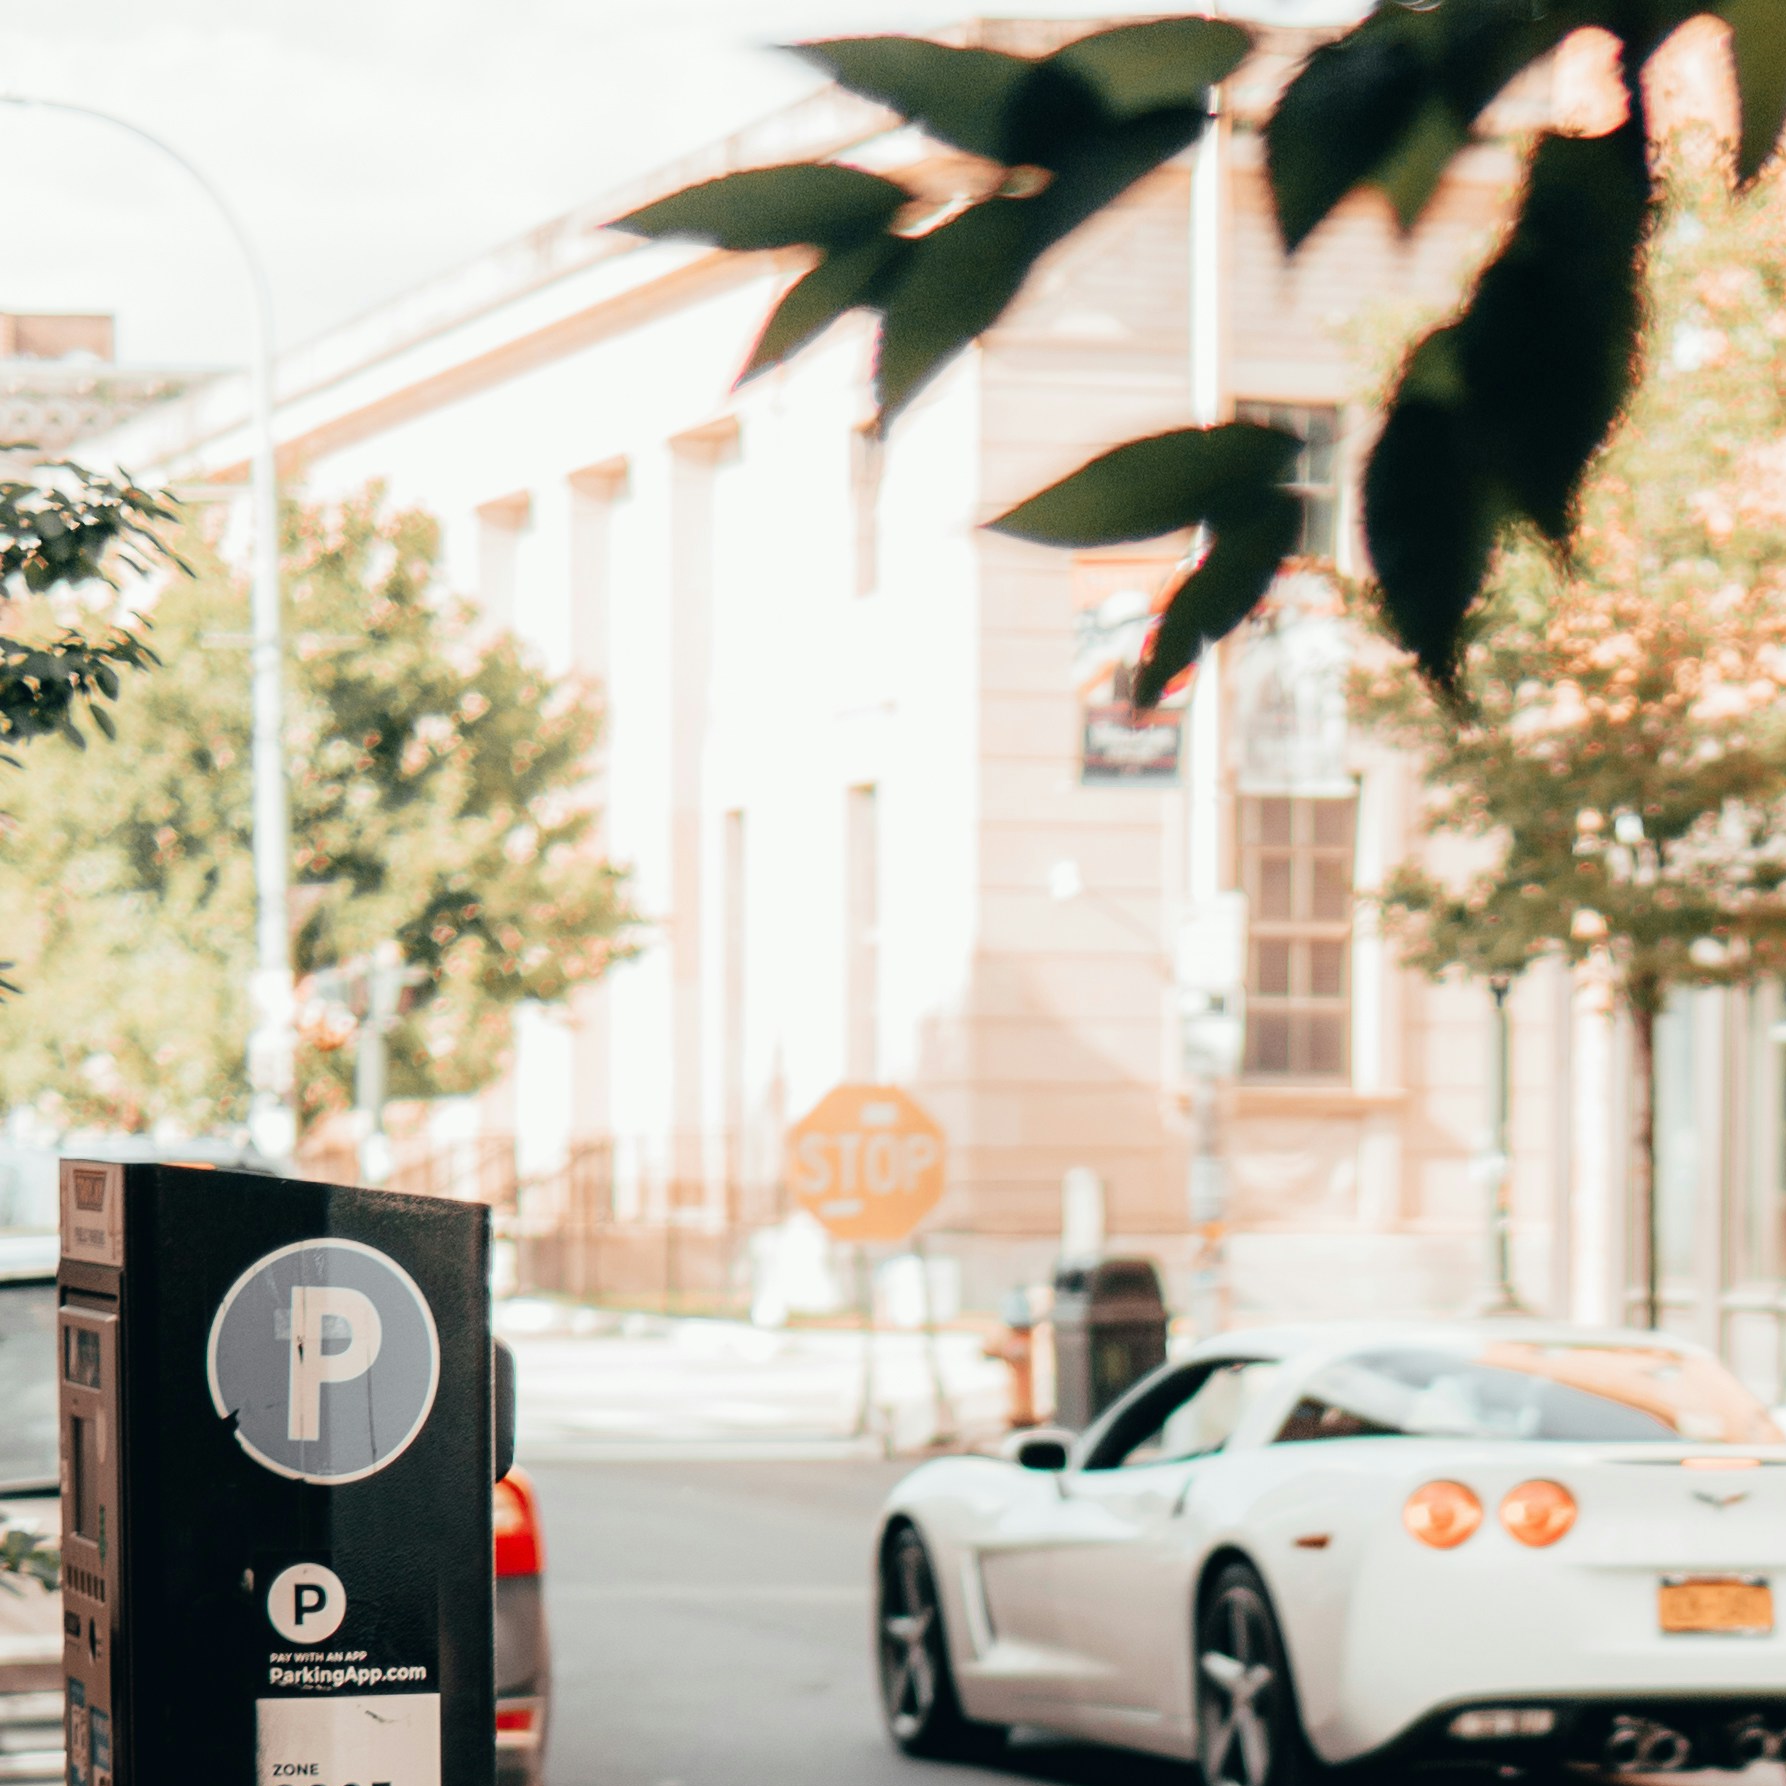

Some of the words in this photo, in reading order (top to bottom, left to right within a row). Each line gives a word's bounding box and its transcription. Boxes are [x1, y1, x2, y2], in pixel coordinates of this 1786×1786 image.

[796, 1132, 937, 1196] STOP
[287, 1286, 383, 1441] P
[294, 1583, 327, 1626] P
[269, 1651, 292, 1663] PAY
[293, 1651, 325, 1663] WITH
[325, 1651, 344, 1663] AN
[344, 1650, 368, 1662] APP
[269, 1665, 427, 1687] ParkingApp.com
[272, 1763, 320, 1776] ZONE
